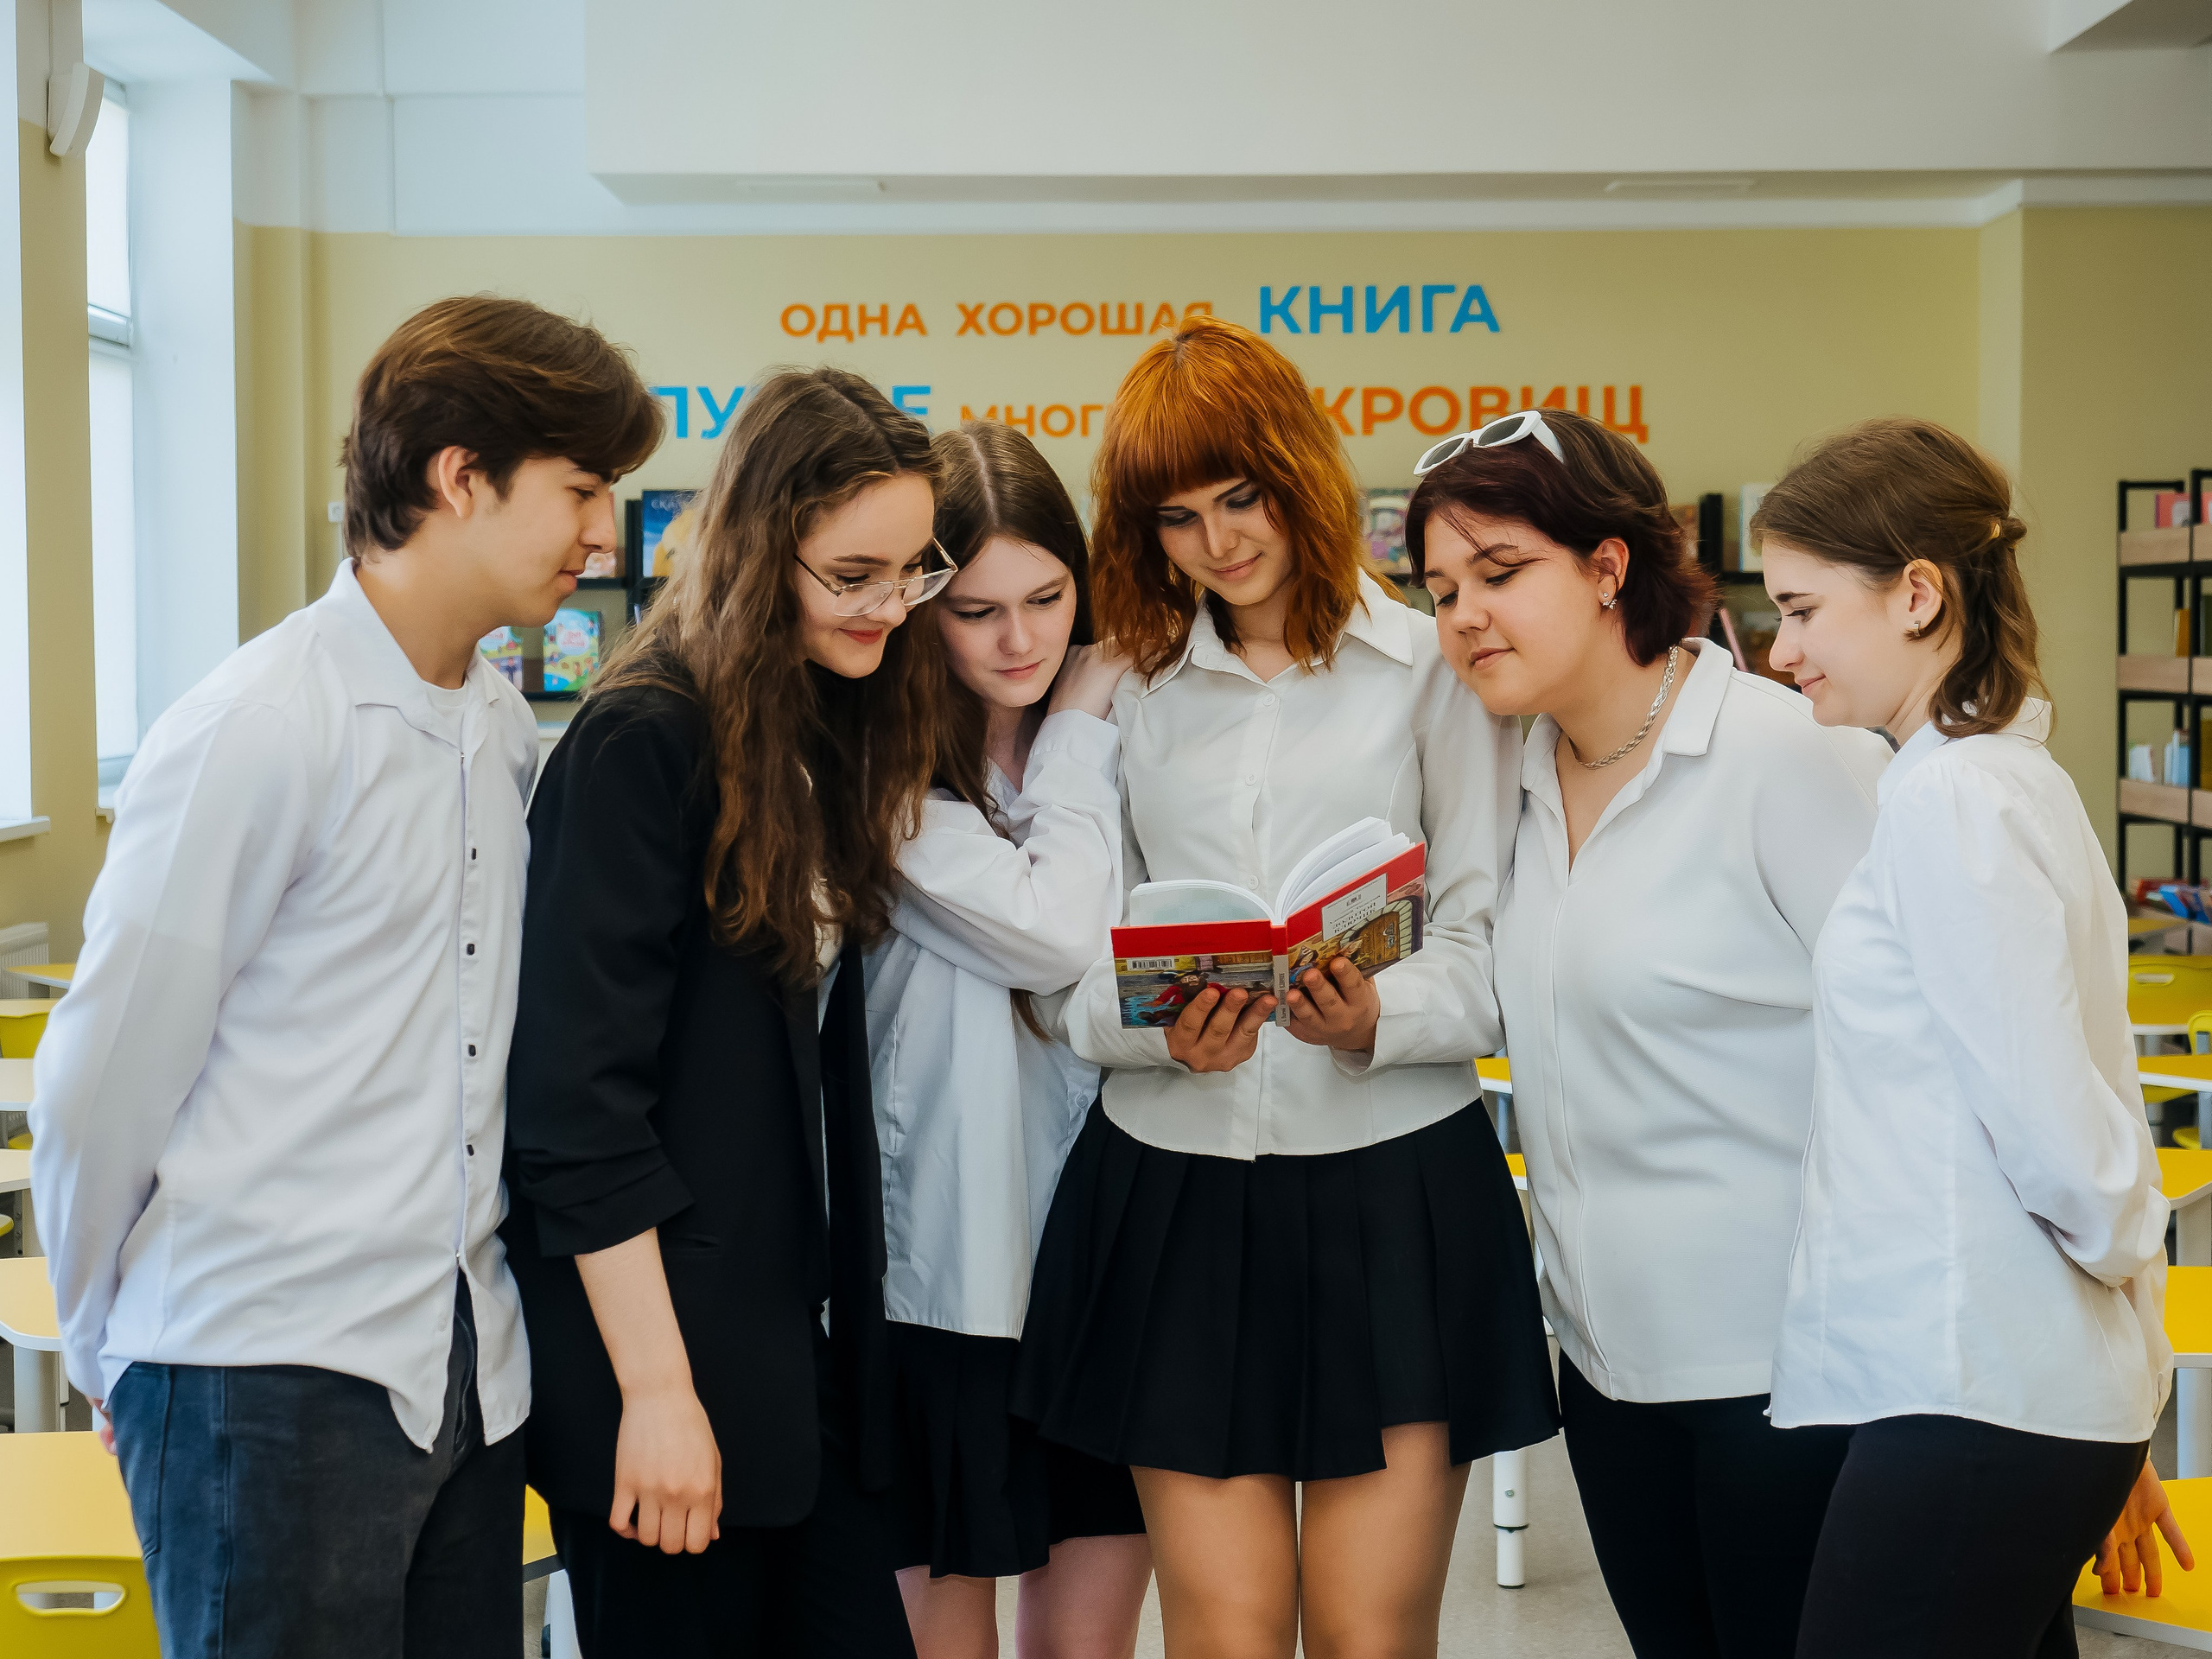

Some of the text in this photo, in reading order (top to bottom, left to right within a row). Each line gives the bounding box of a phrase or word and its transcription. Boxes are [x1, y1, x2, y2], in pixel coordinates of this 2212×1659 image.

[779, 302, 928, 342] ОДНА
[1259, 284, 1500, 334] КНИГА
[647, 385, 1649, 443] ЛУЕ МНОГ КРОВЩ
